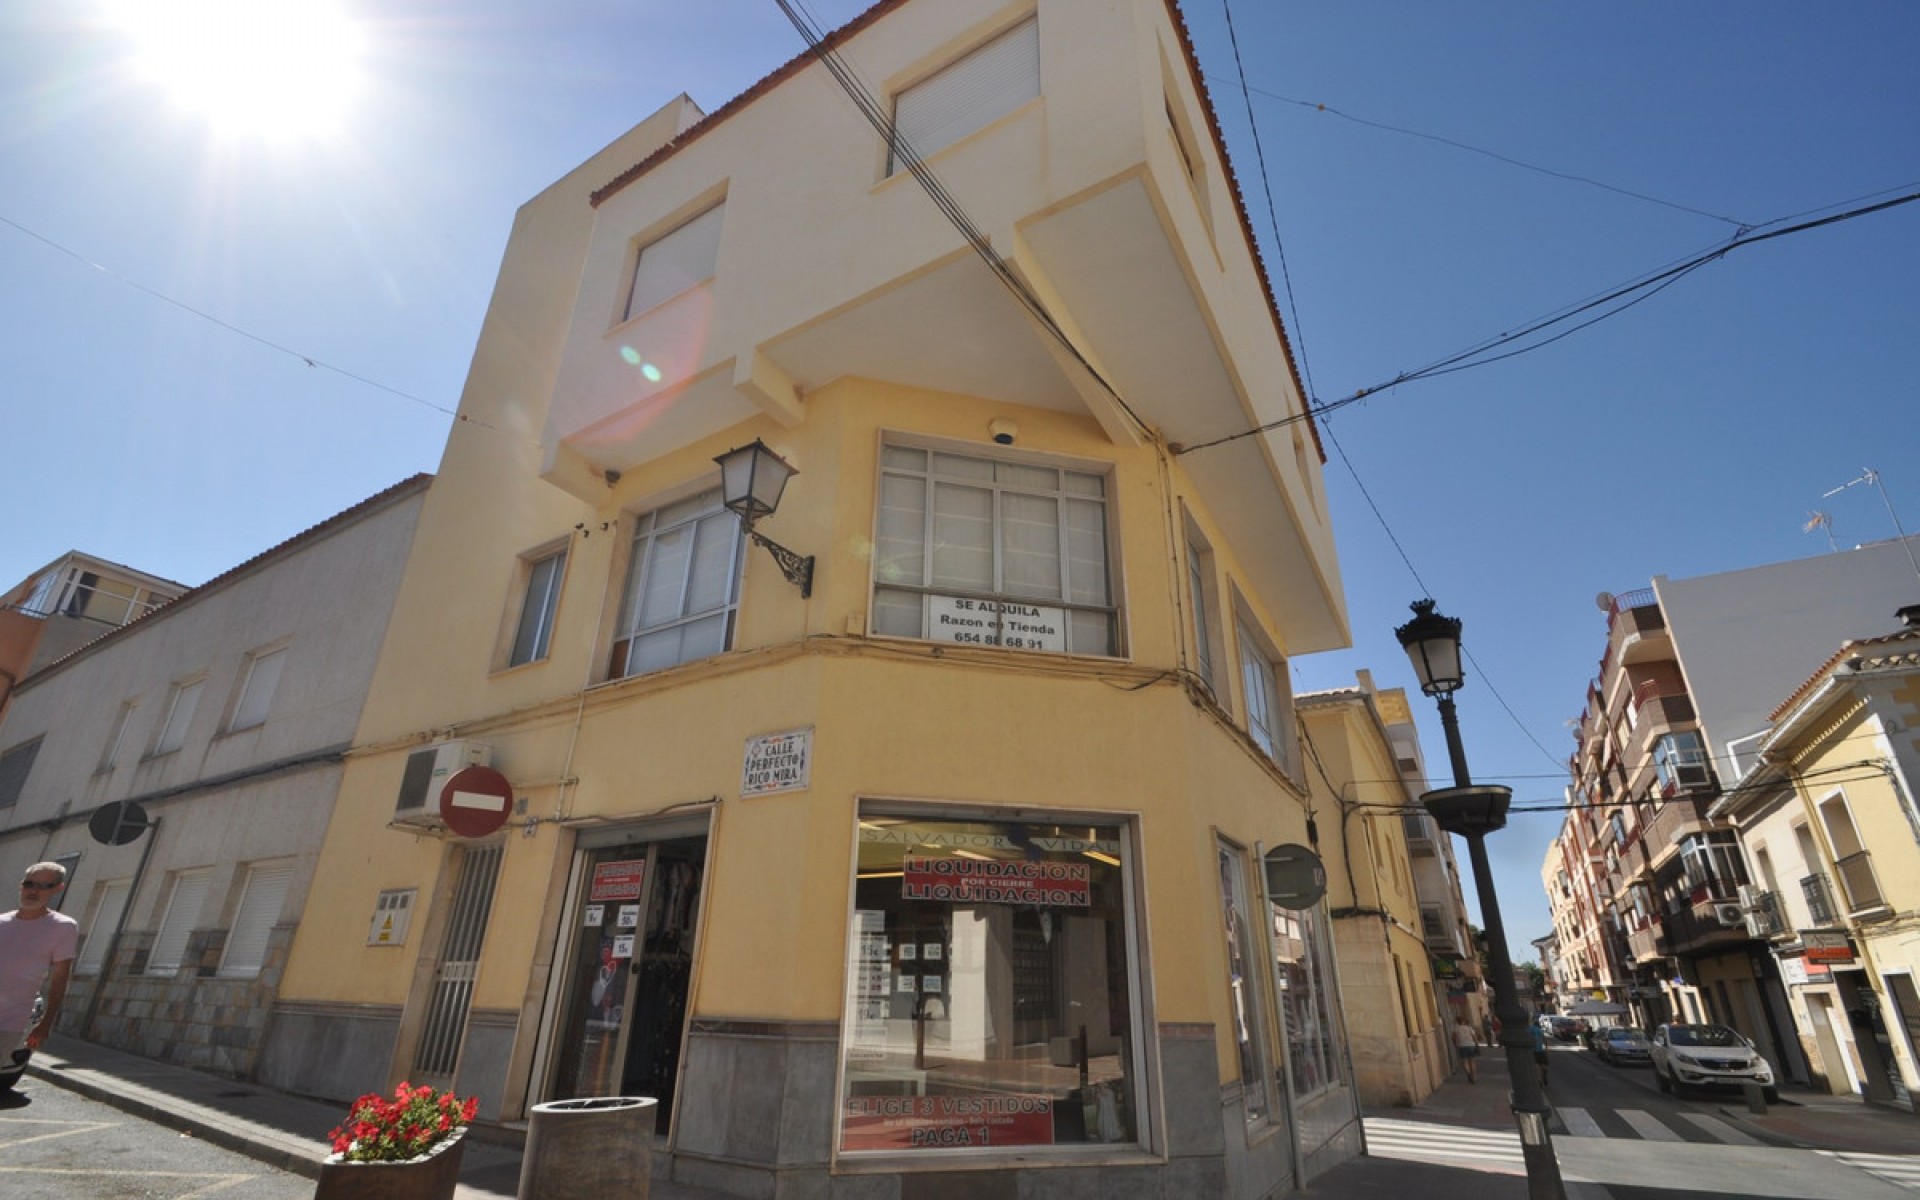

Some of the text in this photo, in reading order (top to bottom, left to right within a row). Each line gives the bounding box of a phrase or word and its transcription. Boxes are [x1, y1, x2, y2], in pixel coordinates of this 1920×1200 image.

[955, 599, 1040, 617] SE ALQUILA
[940, 614, 983, 628] Razon
[1009, 621, 1055, 635] Tienda
[954, 632, 980, 644] 654
[765, 741, 794, 756] CALLE
[750, 754, 799, 771] PERFECTO
[748, 768, 797, 785] RICO MIRA
[866, 830, 1117, 852] SALVADOR VIDAL
[907, 859, 1088, 881] LIQUIDACION
[990, 879, 1034, 888] CIERRE
[907, 883, 1088, 905] LIQUIDACION
[848, 1097, 1050, 1116] ELIGE 3 VESTIDOS
[911, 1126, 990, 1145] PAGA 1
